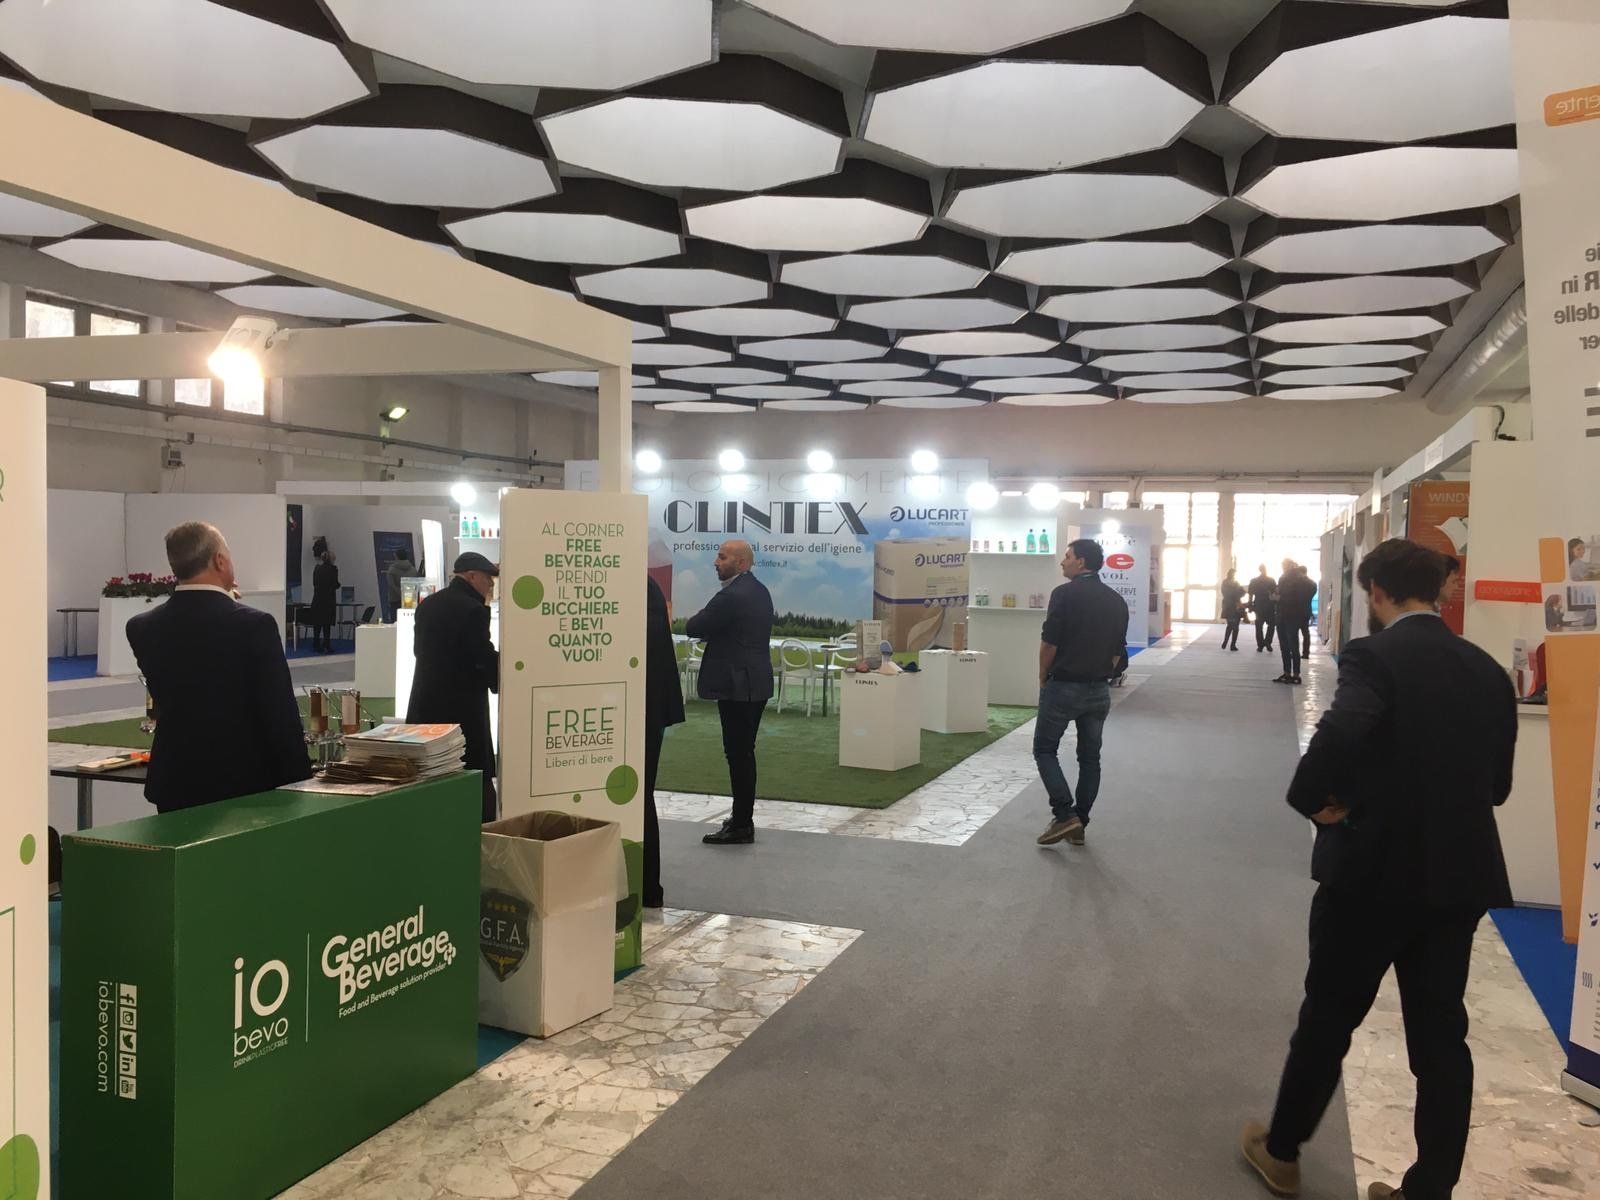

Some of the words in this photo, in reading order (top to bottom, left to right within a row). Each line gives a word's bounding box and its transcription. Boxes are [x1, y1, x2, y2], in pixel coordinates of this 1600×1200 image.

[664, 500, 869, 535] CLINTEX
[908, 508, 969, 520] LUCART
[541, 522, 560, 536] AL
[564, 522, 624, 537] CORNER
[566, 538, 602, 552] FREE
[763, 543, 804, 553] servizio
[808, 543, 862, 556] dell'igiene
[545, 554, 620, 568] BEVERAGE
[926, 553, 967, 565] LUCART
[556, 570, 607, 584] PRENDI
[558, 586, 570, 600] IL
[574, 586, 605, 600] TUO
[541, 602, 619, 616] BICCHIERE
[559, 618, 568, 632] E
[571, 617, 603, 631] BEVI
[548, 632, 613, 648] QUANTO
[562, 648, 603, 662] VUOI!
[546, 706, 614, 736] FREE
[545, 732, 614, 750] BEVERAGE
[545, 757, 576, 769] Liberi
[578, 754, 588, 765] di
[590, 753, 614, 764] bere
[480, 917, 525, 945] G.F.A.
[321, 904, 424, 978] General
[339, 930, 450, 1005] Beverage
[234, 957, 290, 1030] io
[338, 1001, 357, 1018] Food
[357, 995, 370, 1010] and
[370, 984, 400, 1004] Beverage
[399, 973, 424, 990] solution
[423, 962, 448, 981] provider
[98, 980, 114, 1093] iobevo.com
[233, 1017, 289, 1057] bevo
